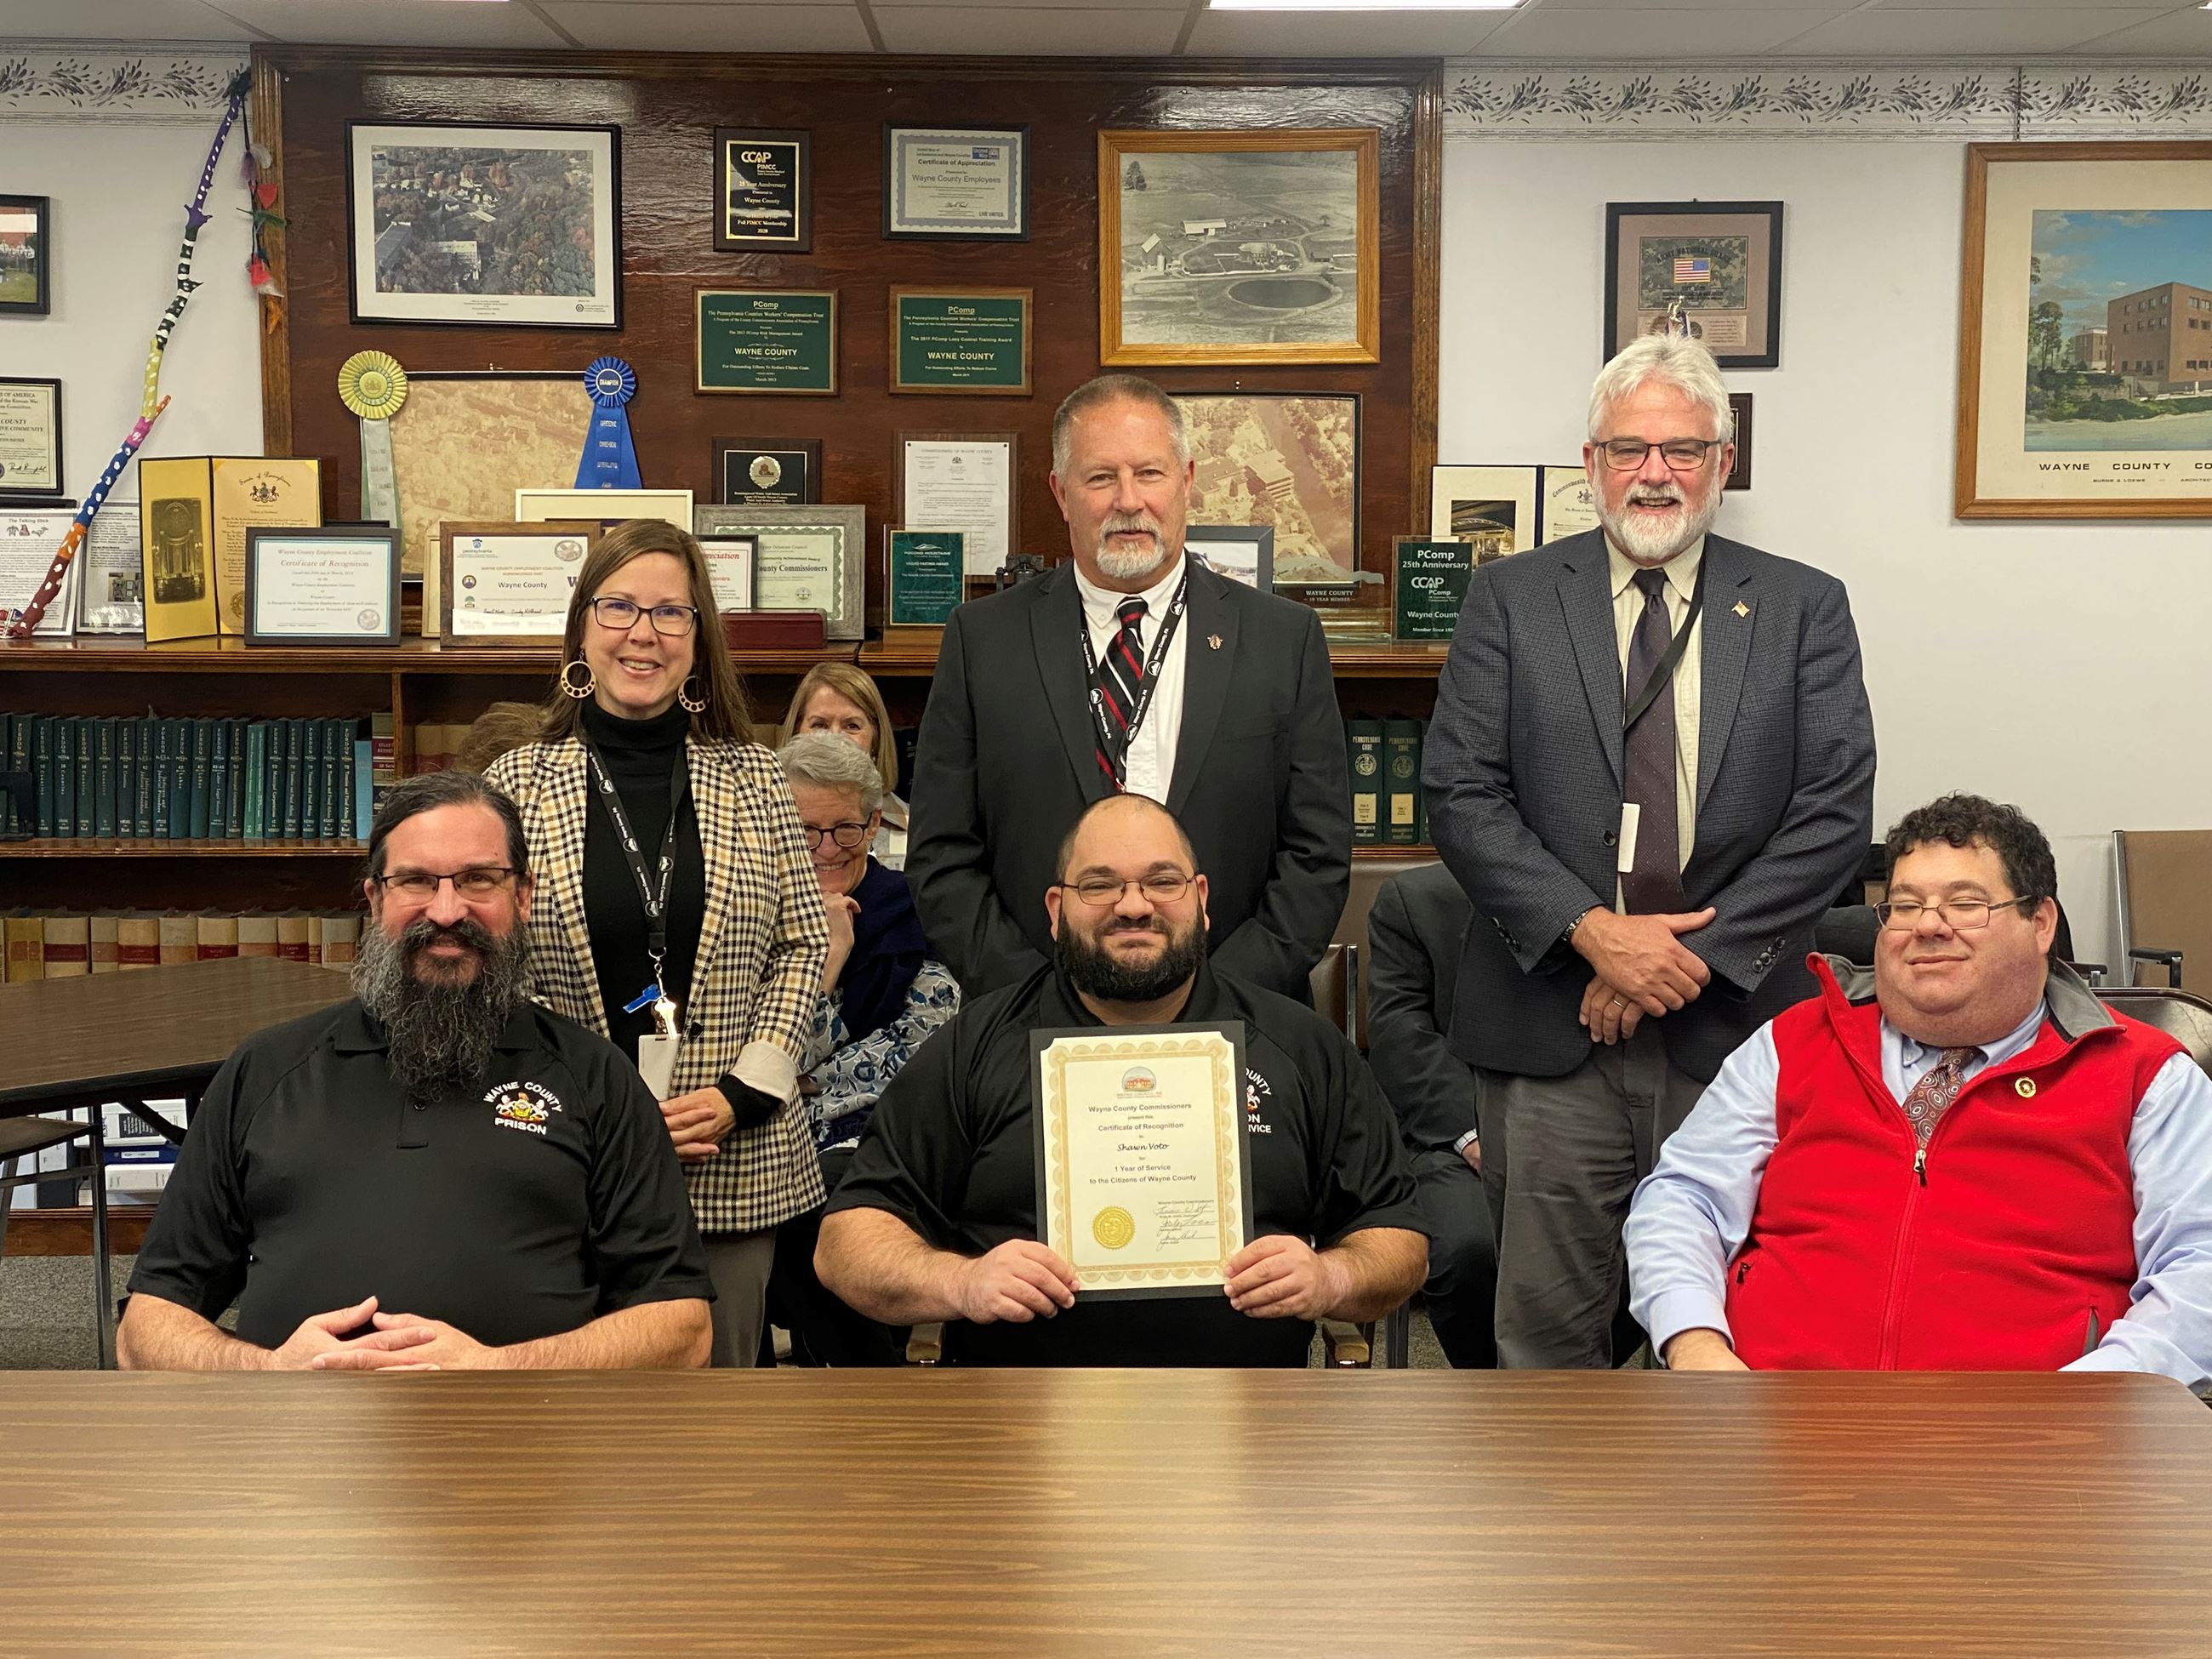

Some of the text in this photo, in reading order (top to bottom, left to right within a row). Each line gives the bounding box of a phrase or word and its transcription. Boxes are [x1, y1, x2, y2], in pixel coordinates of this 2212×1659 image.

[741, 151, 771, 162] CCAP
[938, 175, 961, 184] County
[753, 301, 778, 310] PComp
[948, 306, 975, 315] PComp
[1417, 550, 1455, 561] PComp
[757, 564, 777, 573] ounty
[1422, 562, 1468, 570] Anniversary
[1411, 577, 1444, 589] CCAP
[1246, 1068, 1272, 1095] UNTY
[483, 1081, 562, 1113] WAYNE COUNTY
[495, 1117, 547, 1135] PRISON
[1248, 1124, 1272, 1133] VICE
